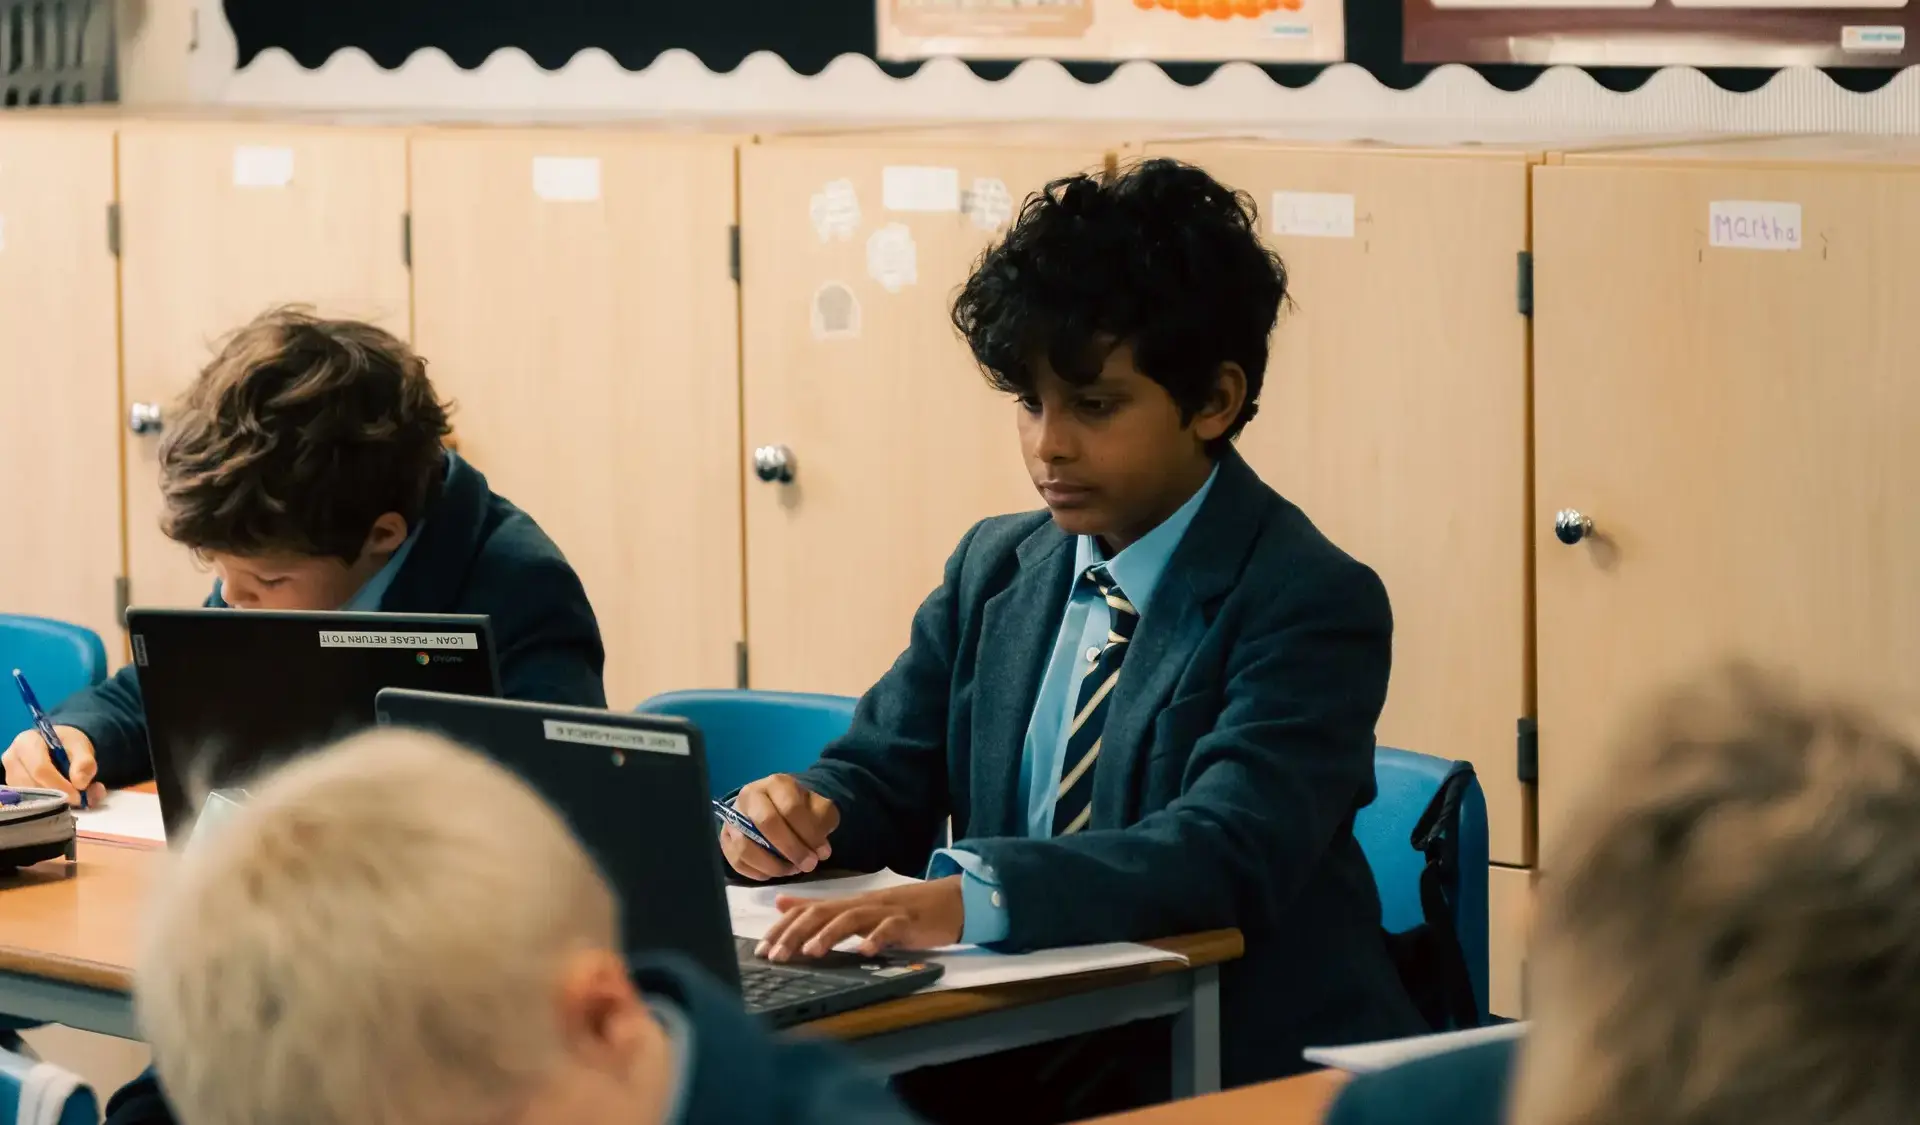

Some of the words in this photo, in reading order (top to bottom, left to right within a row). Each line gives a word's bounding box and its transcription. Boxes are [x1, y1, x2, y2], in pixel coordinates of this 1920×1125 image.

[1714, 214, 1798, 243] Martha
[321, 634, 330, 643] IT
[333, 635, 346, 643] TO
[348, 635, 387, 644] RETURN
[390, 635, 428, 645] PLEASE
[436, 636, 464, 645] LOAN
